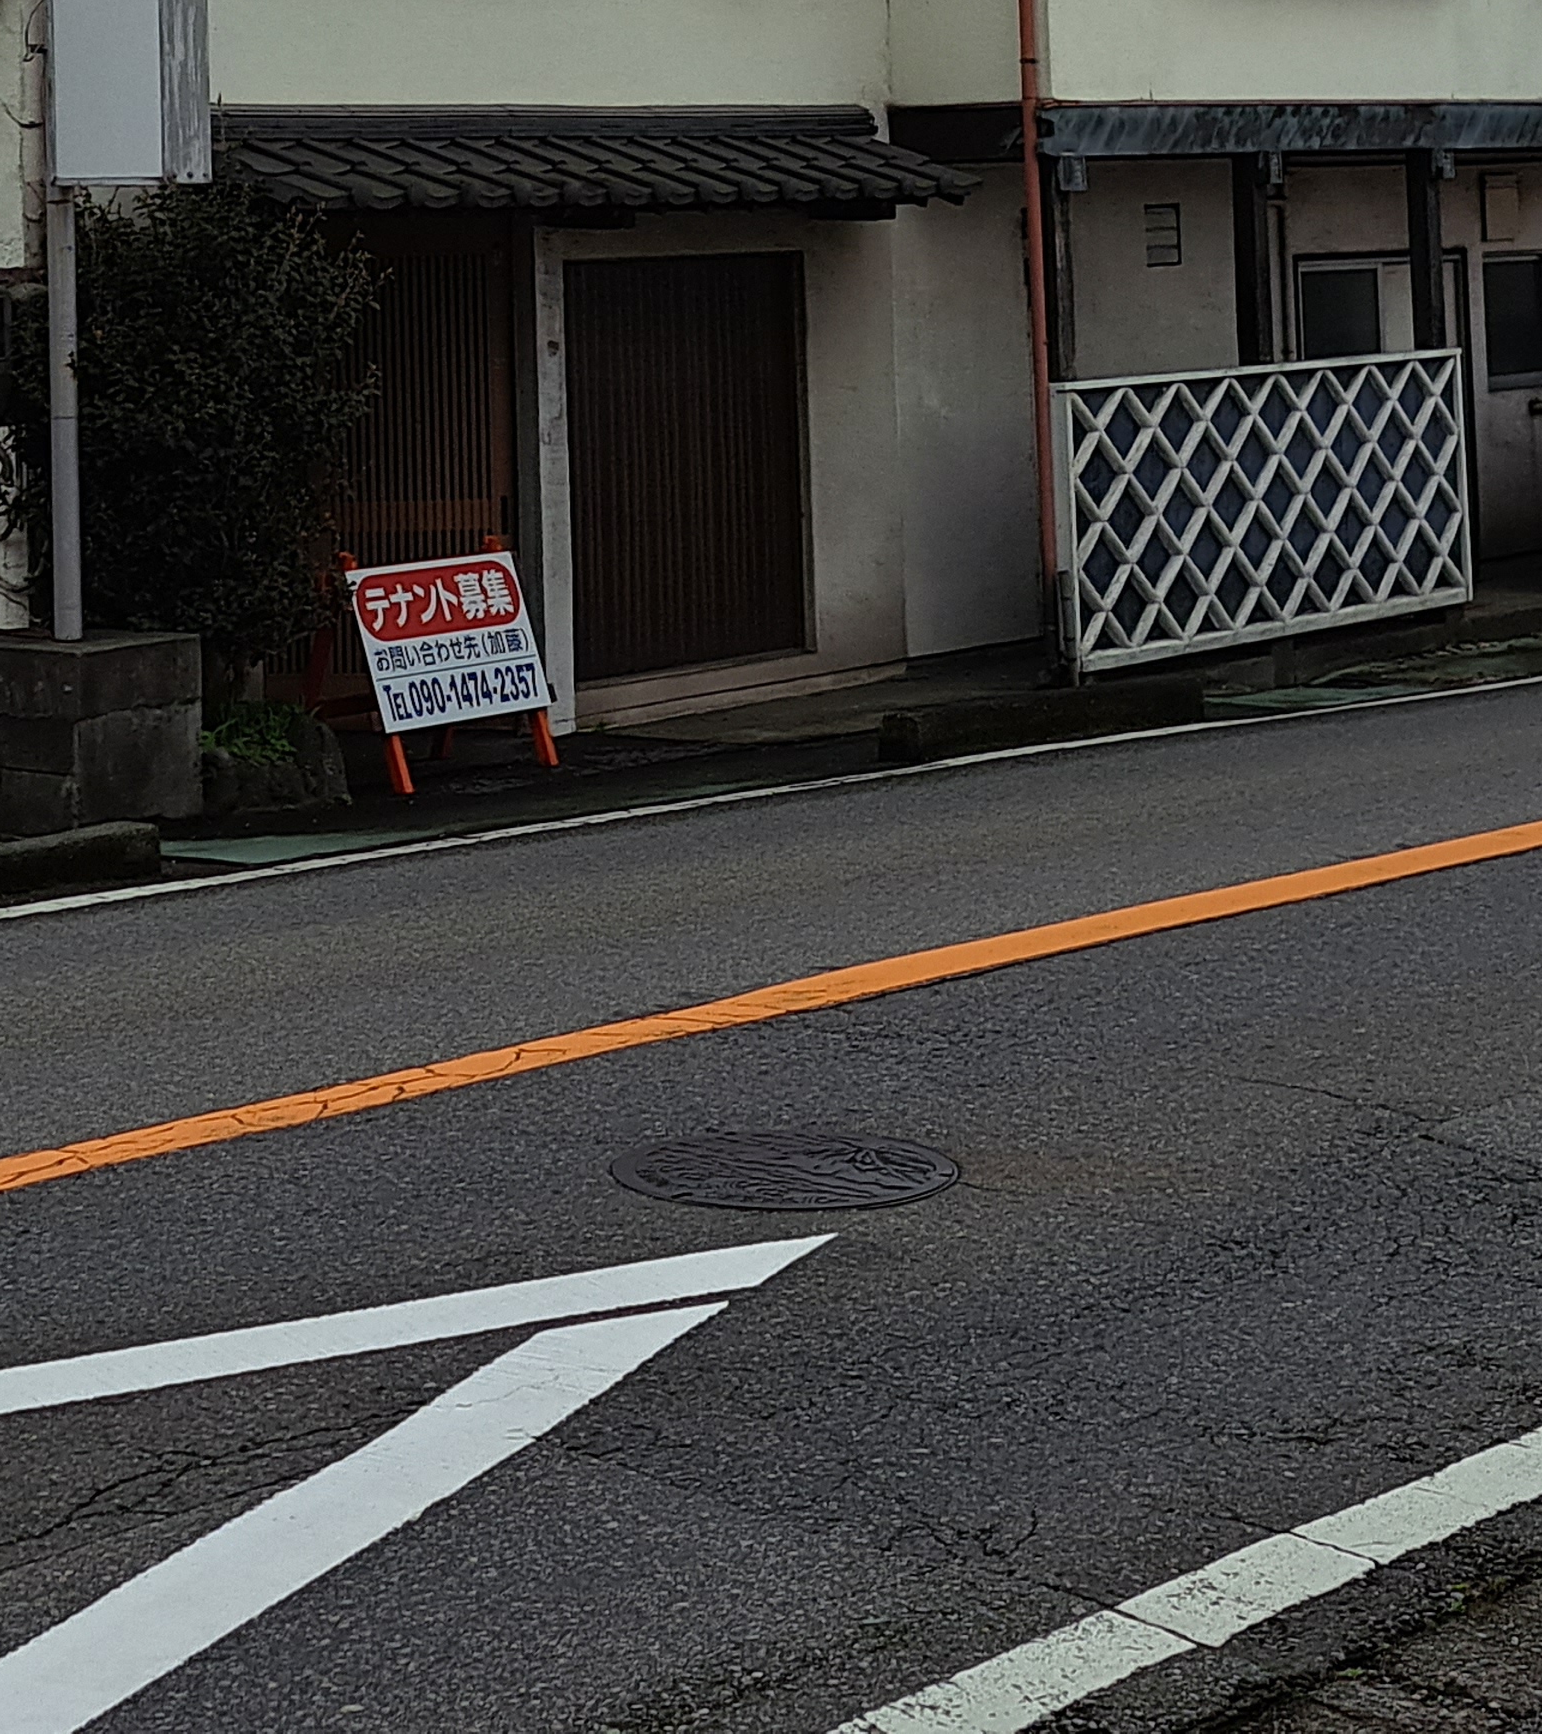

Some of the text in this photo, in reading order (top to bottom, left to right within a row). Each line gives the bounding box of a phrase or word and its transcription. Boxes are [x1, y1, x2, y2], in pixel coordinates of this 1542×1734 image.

[365, 569, 514, 630] テナント募集
